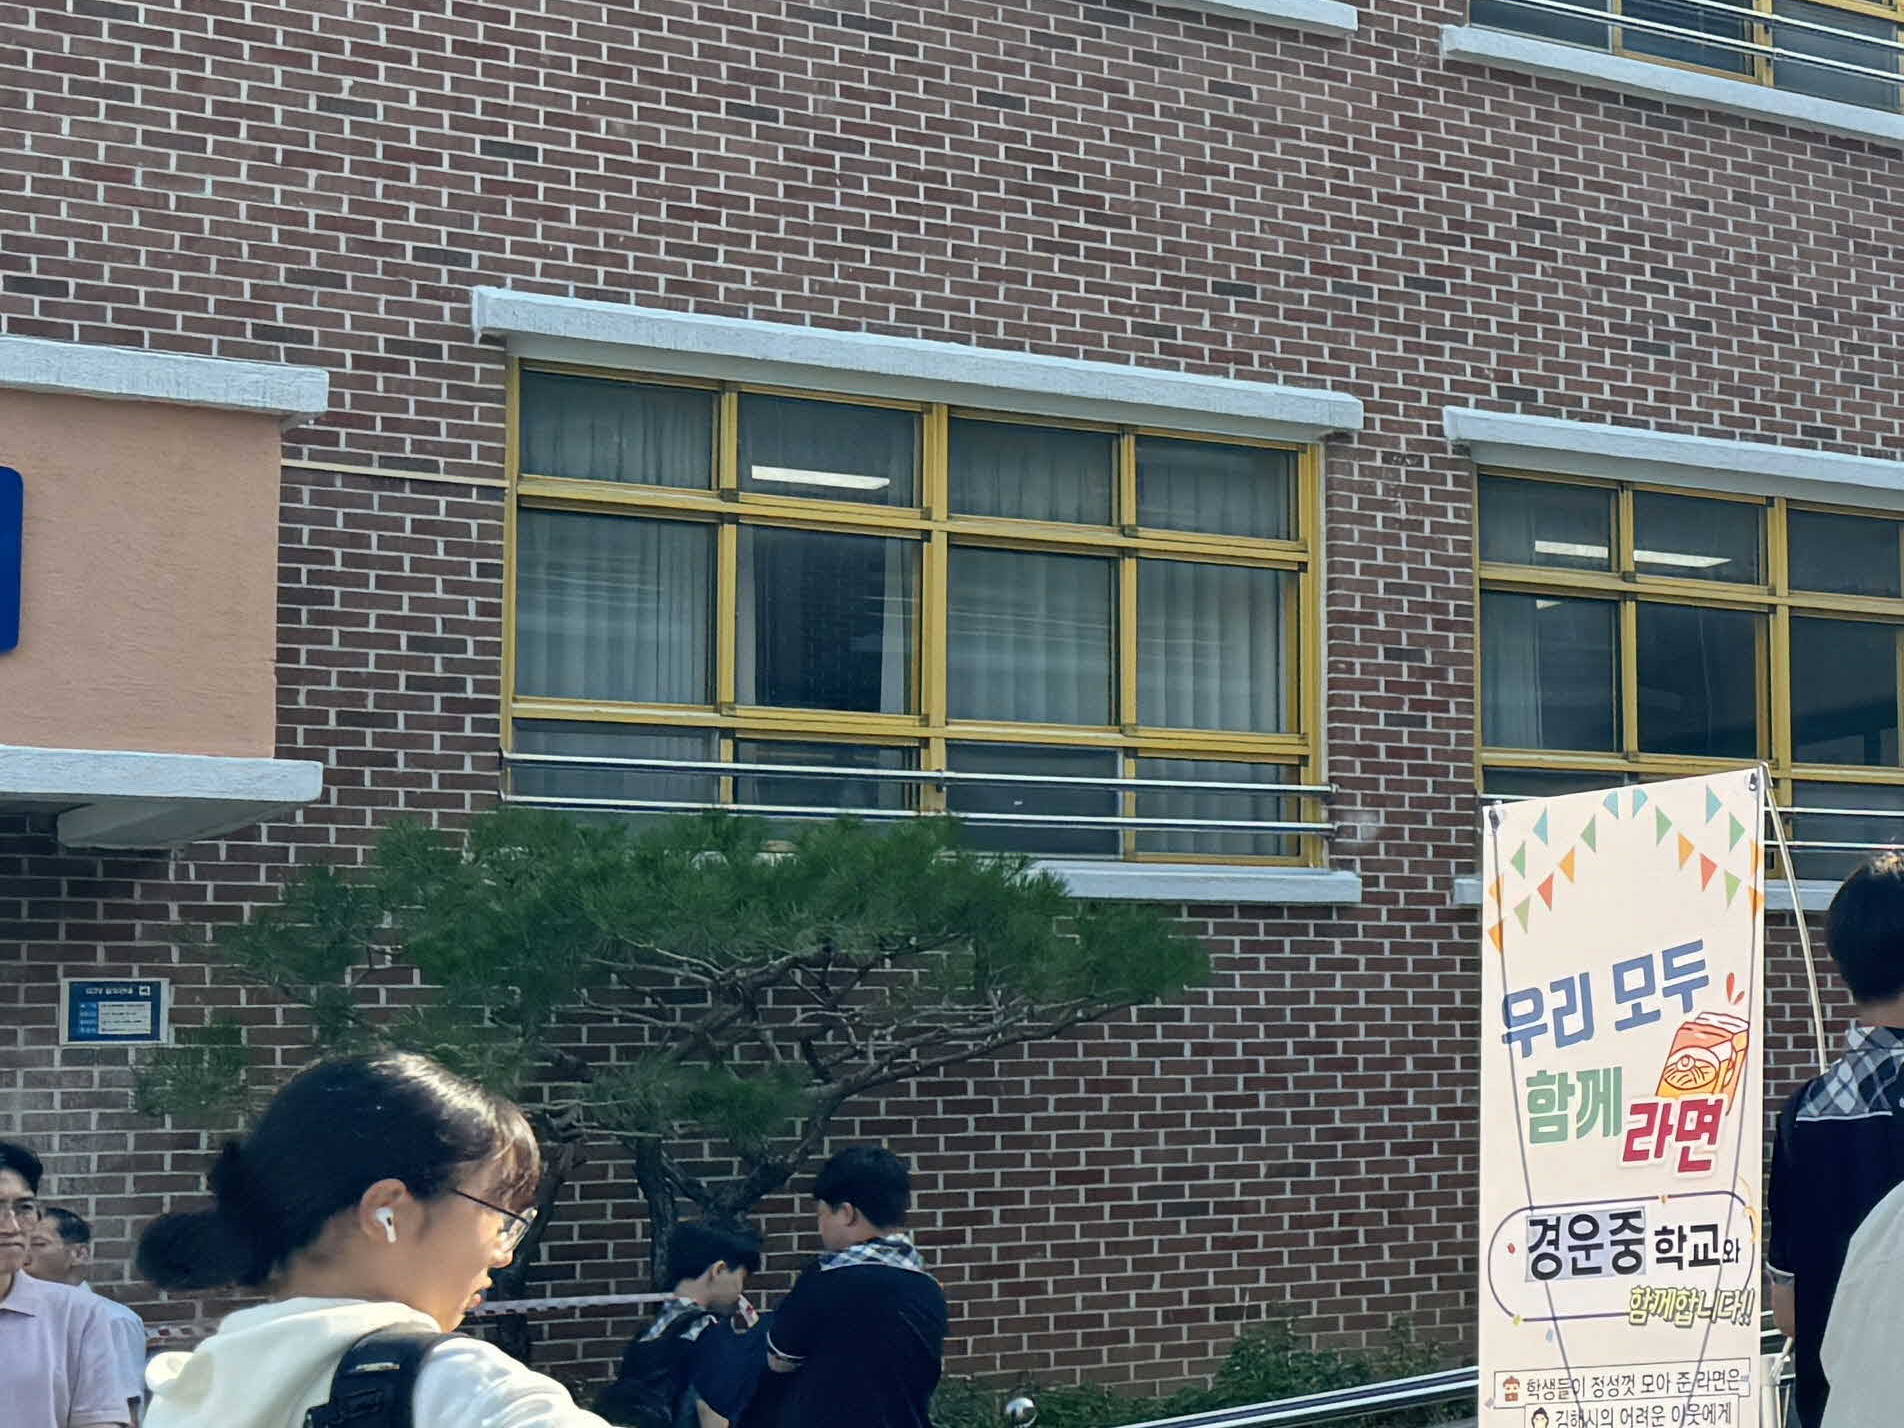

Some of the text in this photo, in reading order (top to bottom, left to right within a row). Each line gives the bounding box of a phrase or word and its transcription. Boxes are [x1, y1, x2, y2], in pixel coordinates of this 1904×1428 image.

[1501, 939, 1710, 1060] 우리 모두
[1525, 1066, 1726, 1174] 함께 라면
[1526, 1376, 1586, 1401] 학생들이
[1590, 1373, 1636, 1399] 정성껏
[1640, 1372, 1672, 1395] 모아
[1676, 1371, 1693, 1394] 준
[1619, 1405, 1666, 1428] 어려운
[1671, 1401, 1732, 1427] 이웃에게
